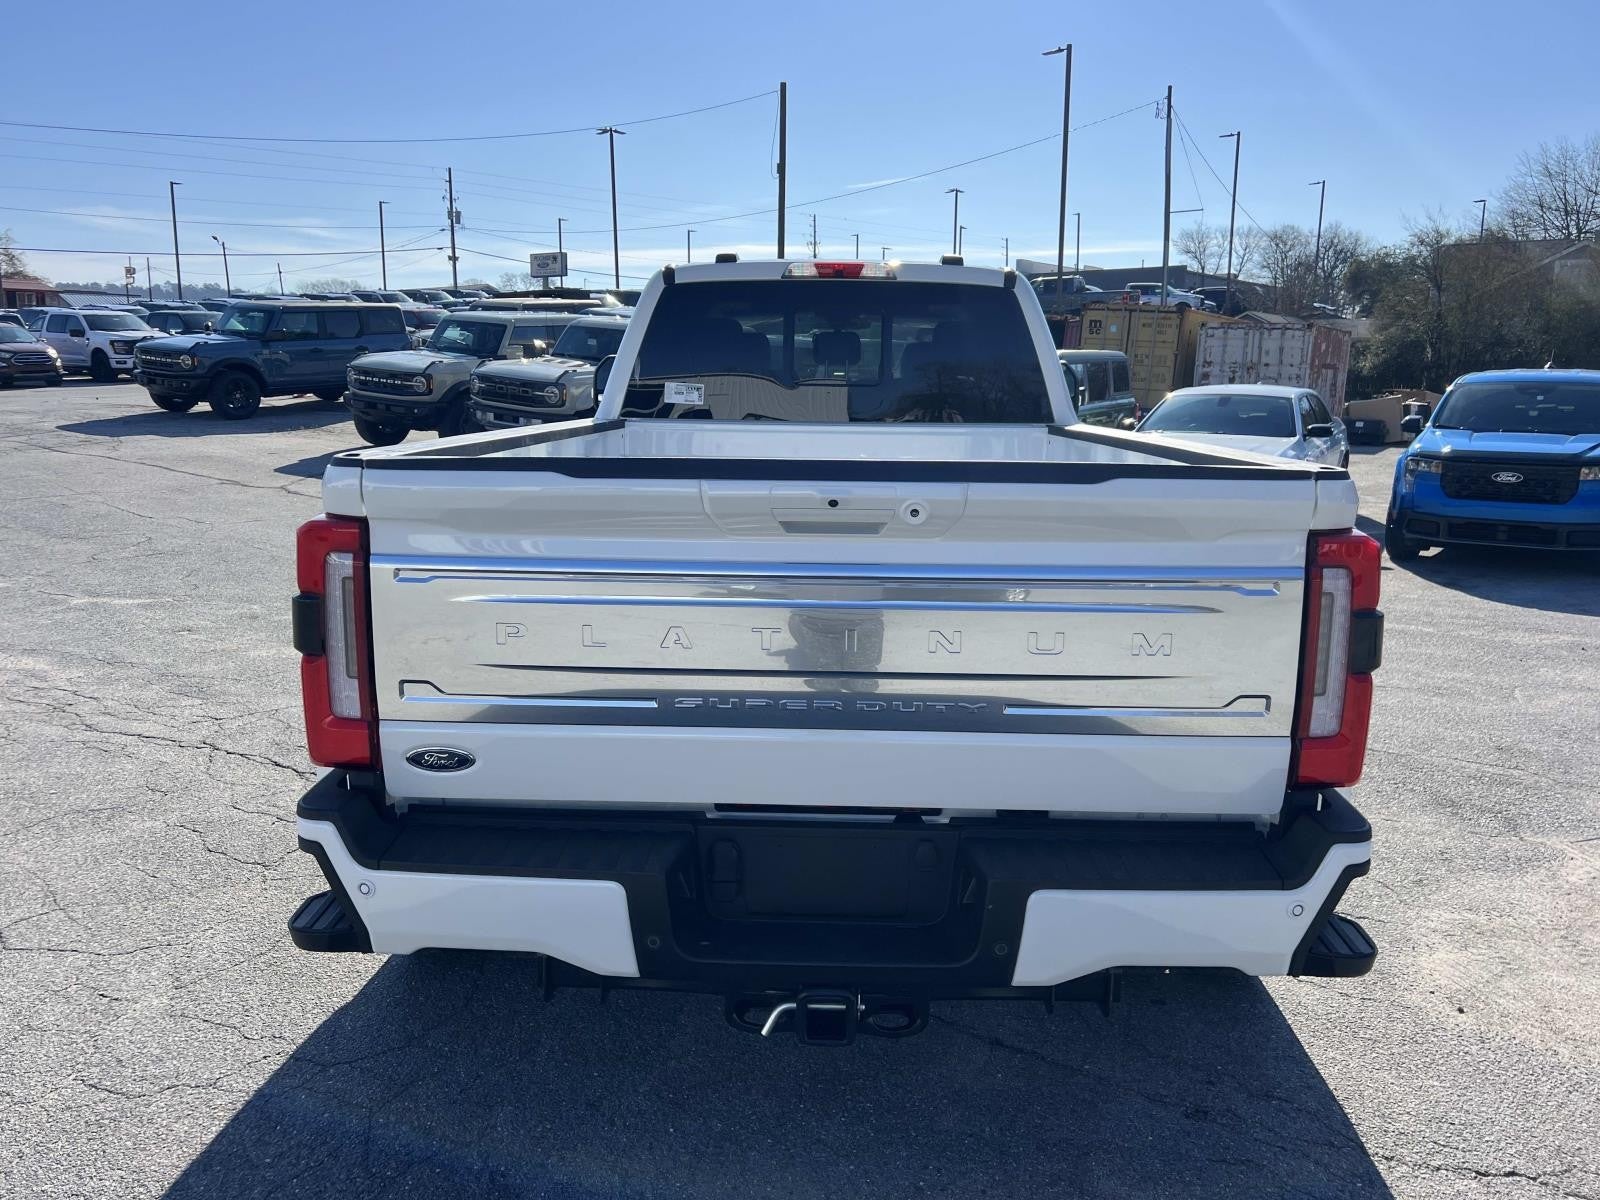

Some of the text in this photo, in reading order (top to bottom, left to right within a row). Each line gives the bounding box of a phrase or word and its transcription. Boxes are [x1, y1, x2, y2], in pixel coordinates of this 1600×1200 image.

[359, 375, 402, 385] BRONCO
[495, 621, 1173, 657] PLATINUM
[674, 697, 989, 713] SUPER DUTY
